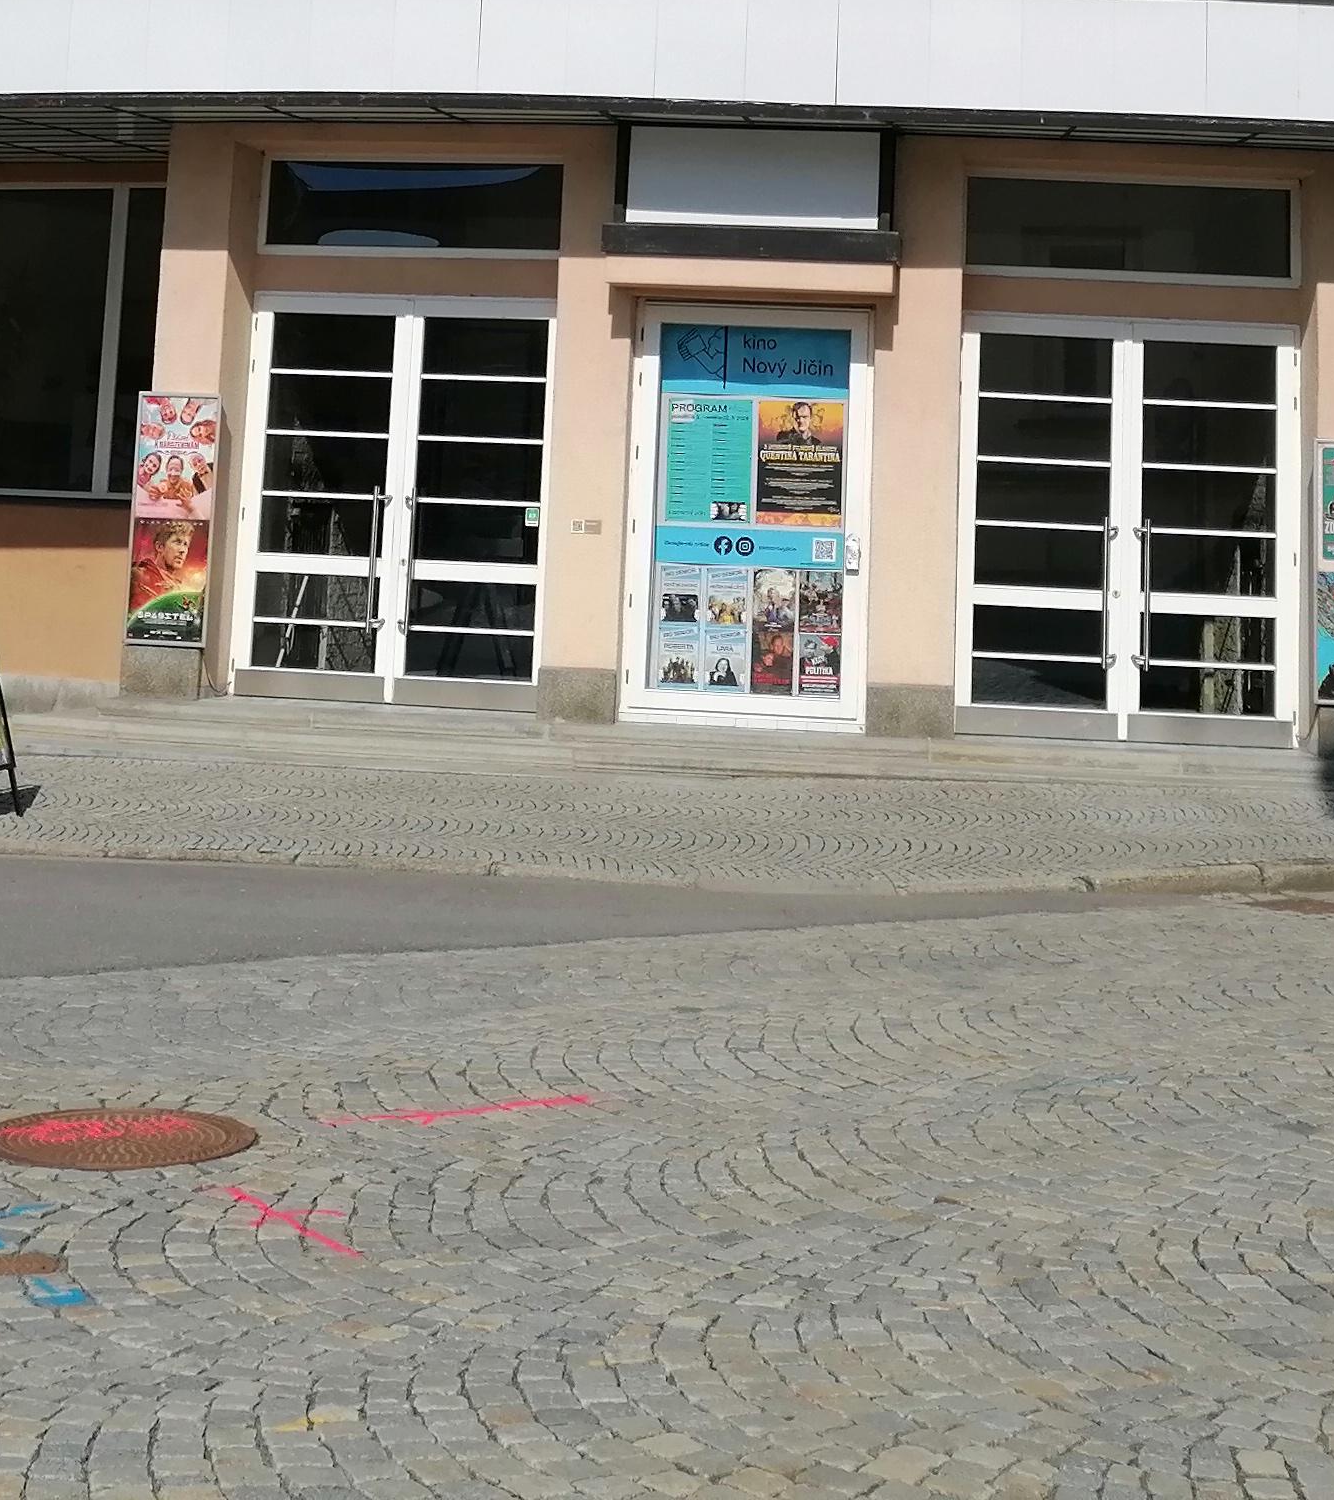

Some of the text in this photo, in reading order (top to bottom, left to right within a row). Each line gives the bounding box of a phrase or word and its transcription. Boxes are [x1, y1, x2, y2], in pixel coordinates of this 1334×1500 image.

[743, 333, 777, 350] kino
[742, 357, 787, 378] Nový
[671, 403, 727, 413] PROGRAM
